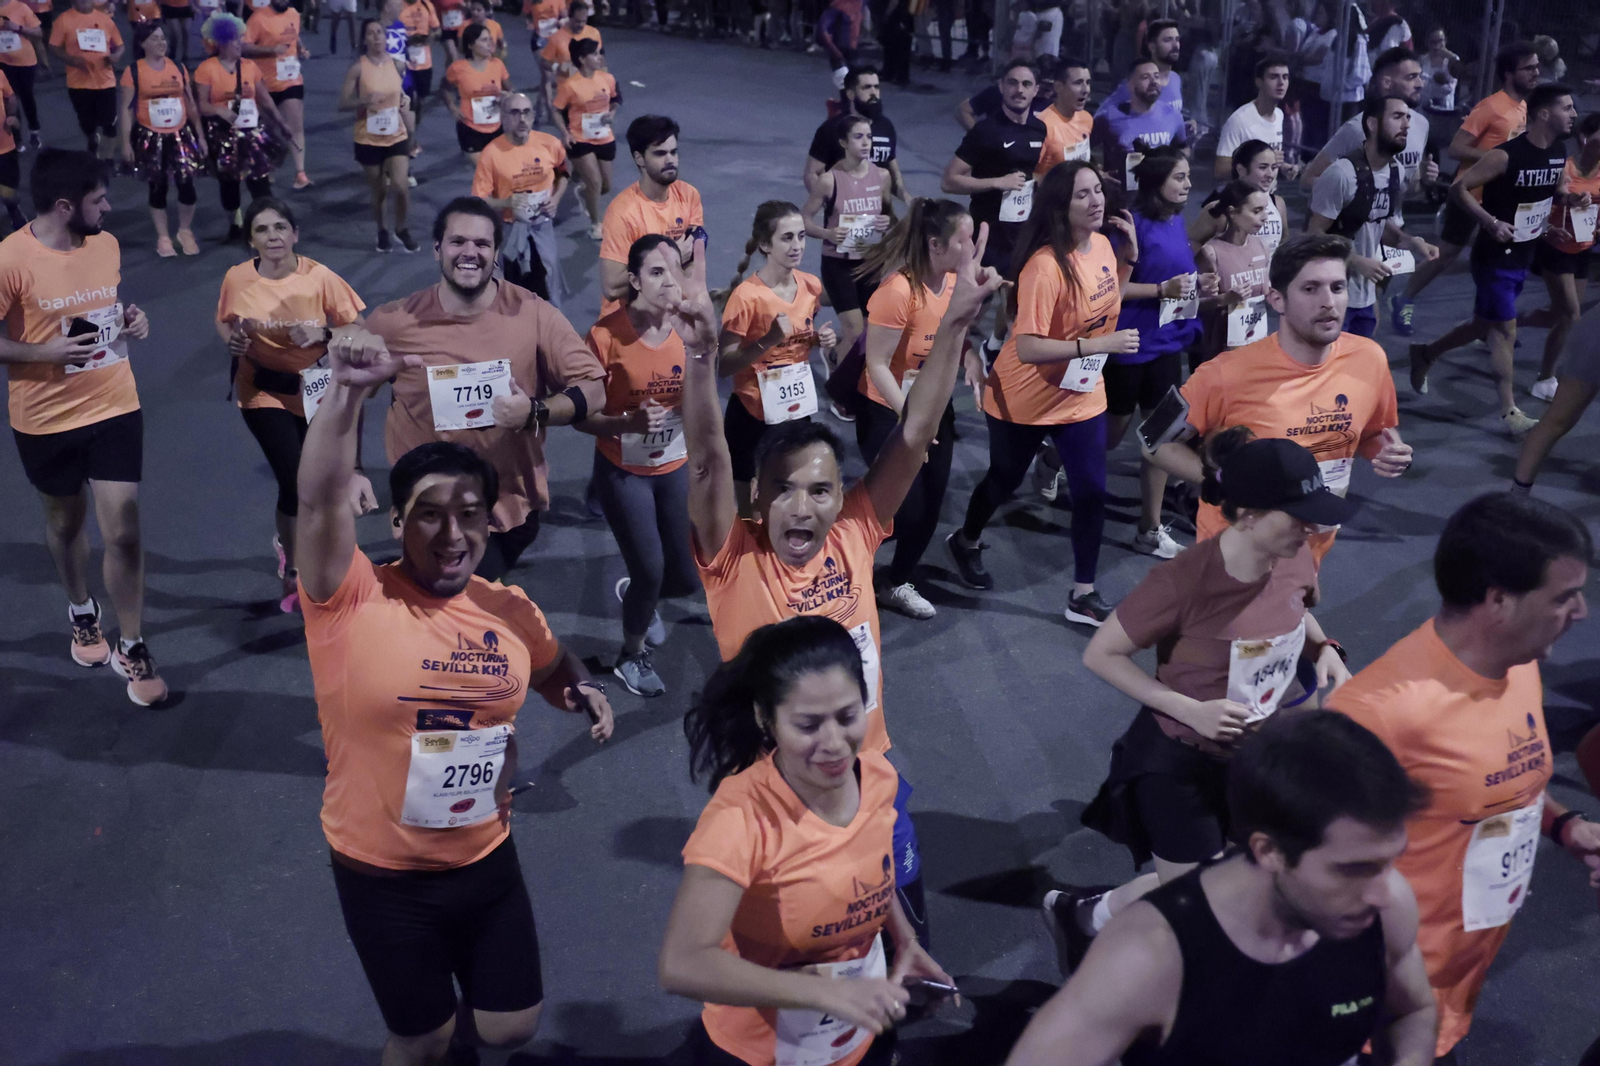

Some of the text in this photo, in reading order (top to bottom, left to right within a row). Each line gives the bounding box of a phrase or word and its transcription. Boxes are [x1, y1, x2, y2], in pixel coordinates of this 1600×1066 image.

[1515, 168, 1564, 186] ATHLET
[39, 286, 117, 310] bankinte
[305, 374, 331, 397] 8996
[647, 380, 682, 388] NOCTURN
[779, 382, 805, 400] 3153
[454, 384, 493, 403] 7719
[1306, 413, 1352, 424] NOCTURNA
[1286, 421, 1352, 437] SEVILLA KH7
[801, 572, 849, 599] NOCTURNA
[826, 581, 851, 602] KH7
[450, 652, 509, 664] NOCTURNA
[421, 659, 509, 677] SEVILLA KH7
[442, 761, 494, 789] 2796
[811, 911, 872, 938] SEVILLA
